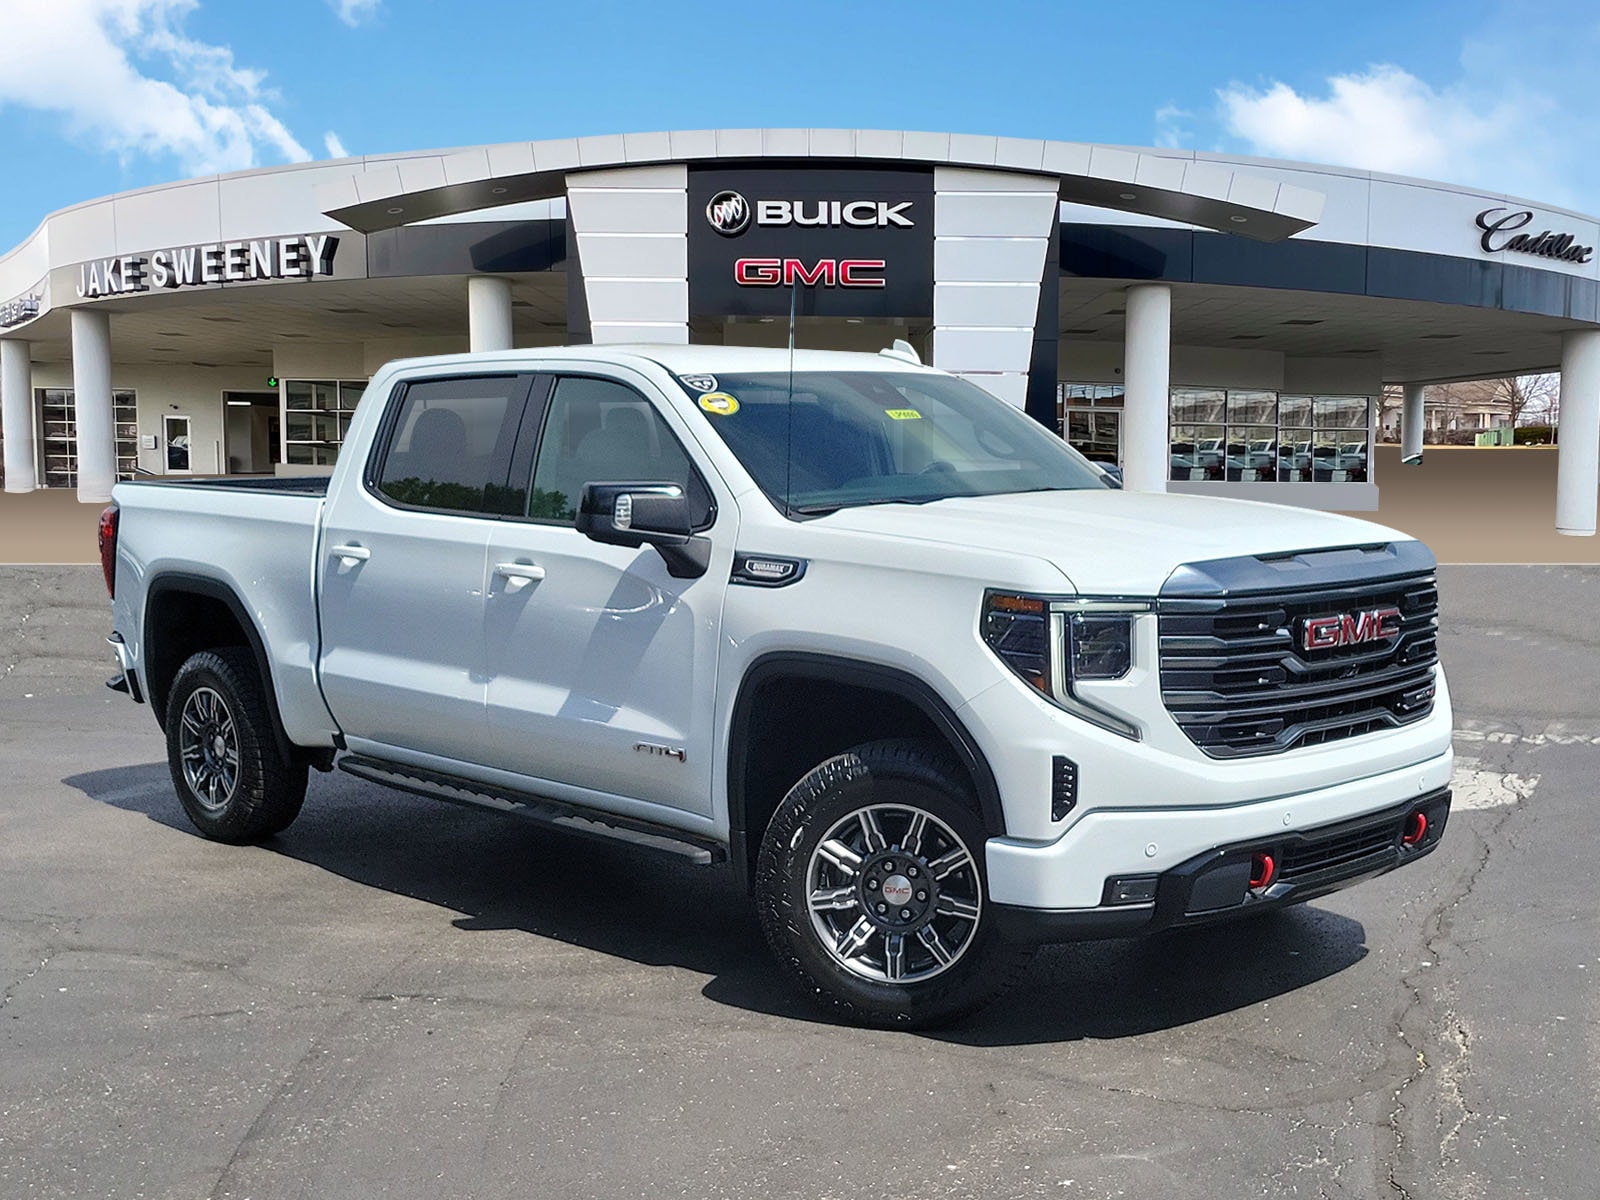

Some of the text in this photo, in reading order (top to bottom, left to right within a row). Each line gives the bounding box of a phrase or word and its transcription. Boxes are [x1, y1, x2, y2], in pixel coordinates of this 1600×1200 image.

[757, 200, 915, 226] BUICK
[1475, 207, 1593, 264] Cadillac
[76, 235, 337, 298] JAKE SWEENEY
[735, 257, 886, 287] GMC
[1303, 607, 1399, 651] GMC
[884, 886, 910, 895] GMC
